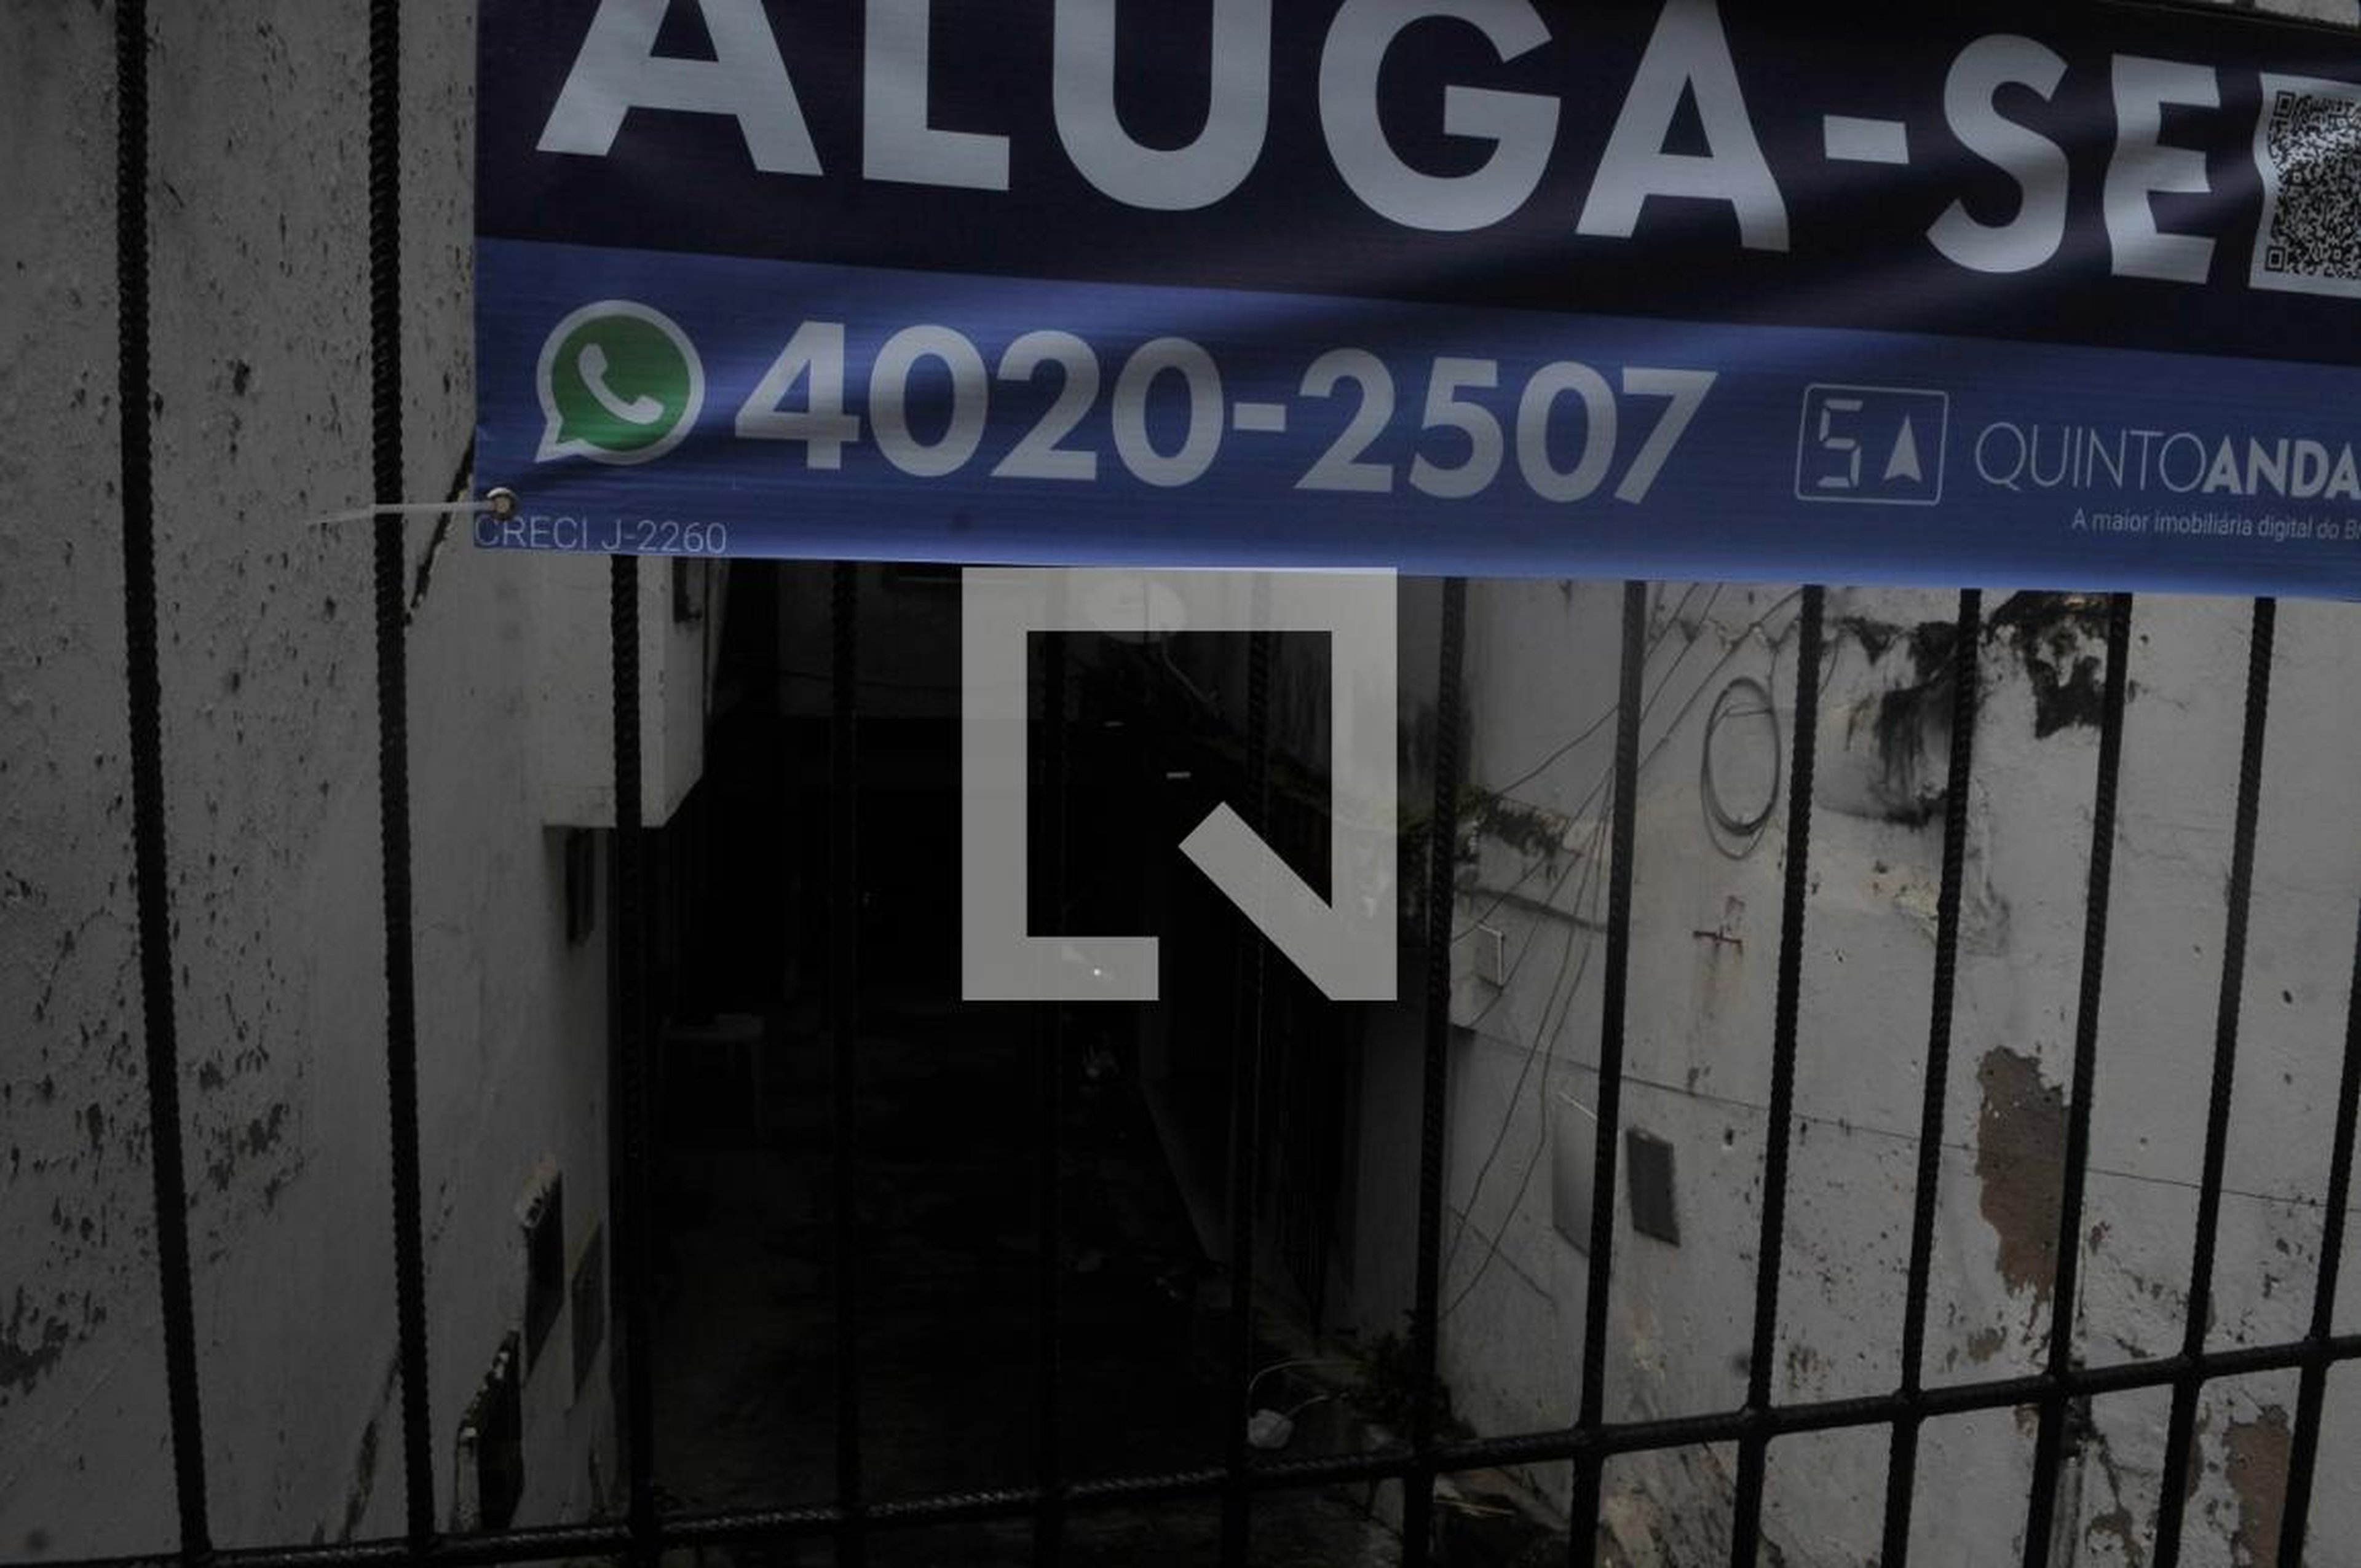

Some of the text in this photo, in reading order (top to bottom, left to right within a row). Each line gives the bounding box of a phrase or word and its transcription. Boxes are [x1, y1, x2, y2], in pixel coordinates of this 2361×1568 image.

[535, 0, 2221, 285] ALUGA-SE
[735, 321, 1718, 503] 4020-2507
[474, 514, 727, 553] CRECI J-2260
[2072, 508, 2087, 531] A
[2093, 510, 2149, 533] maior
[2155, 510, 2253, 536] imobiliária
[2258, 514, 2312, 542] digital
[2317, 516, 2339, 539] do
